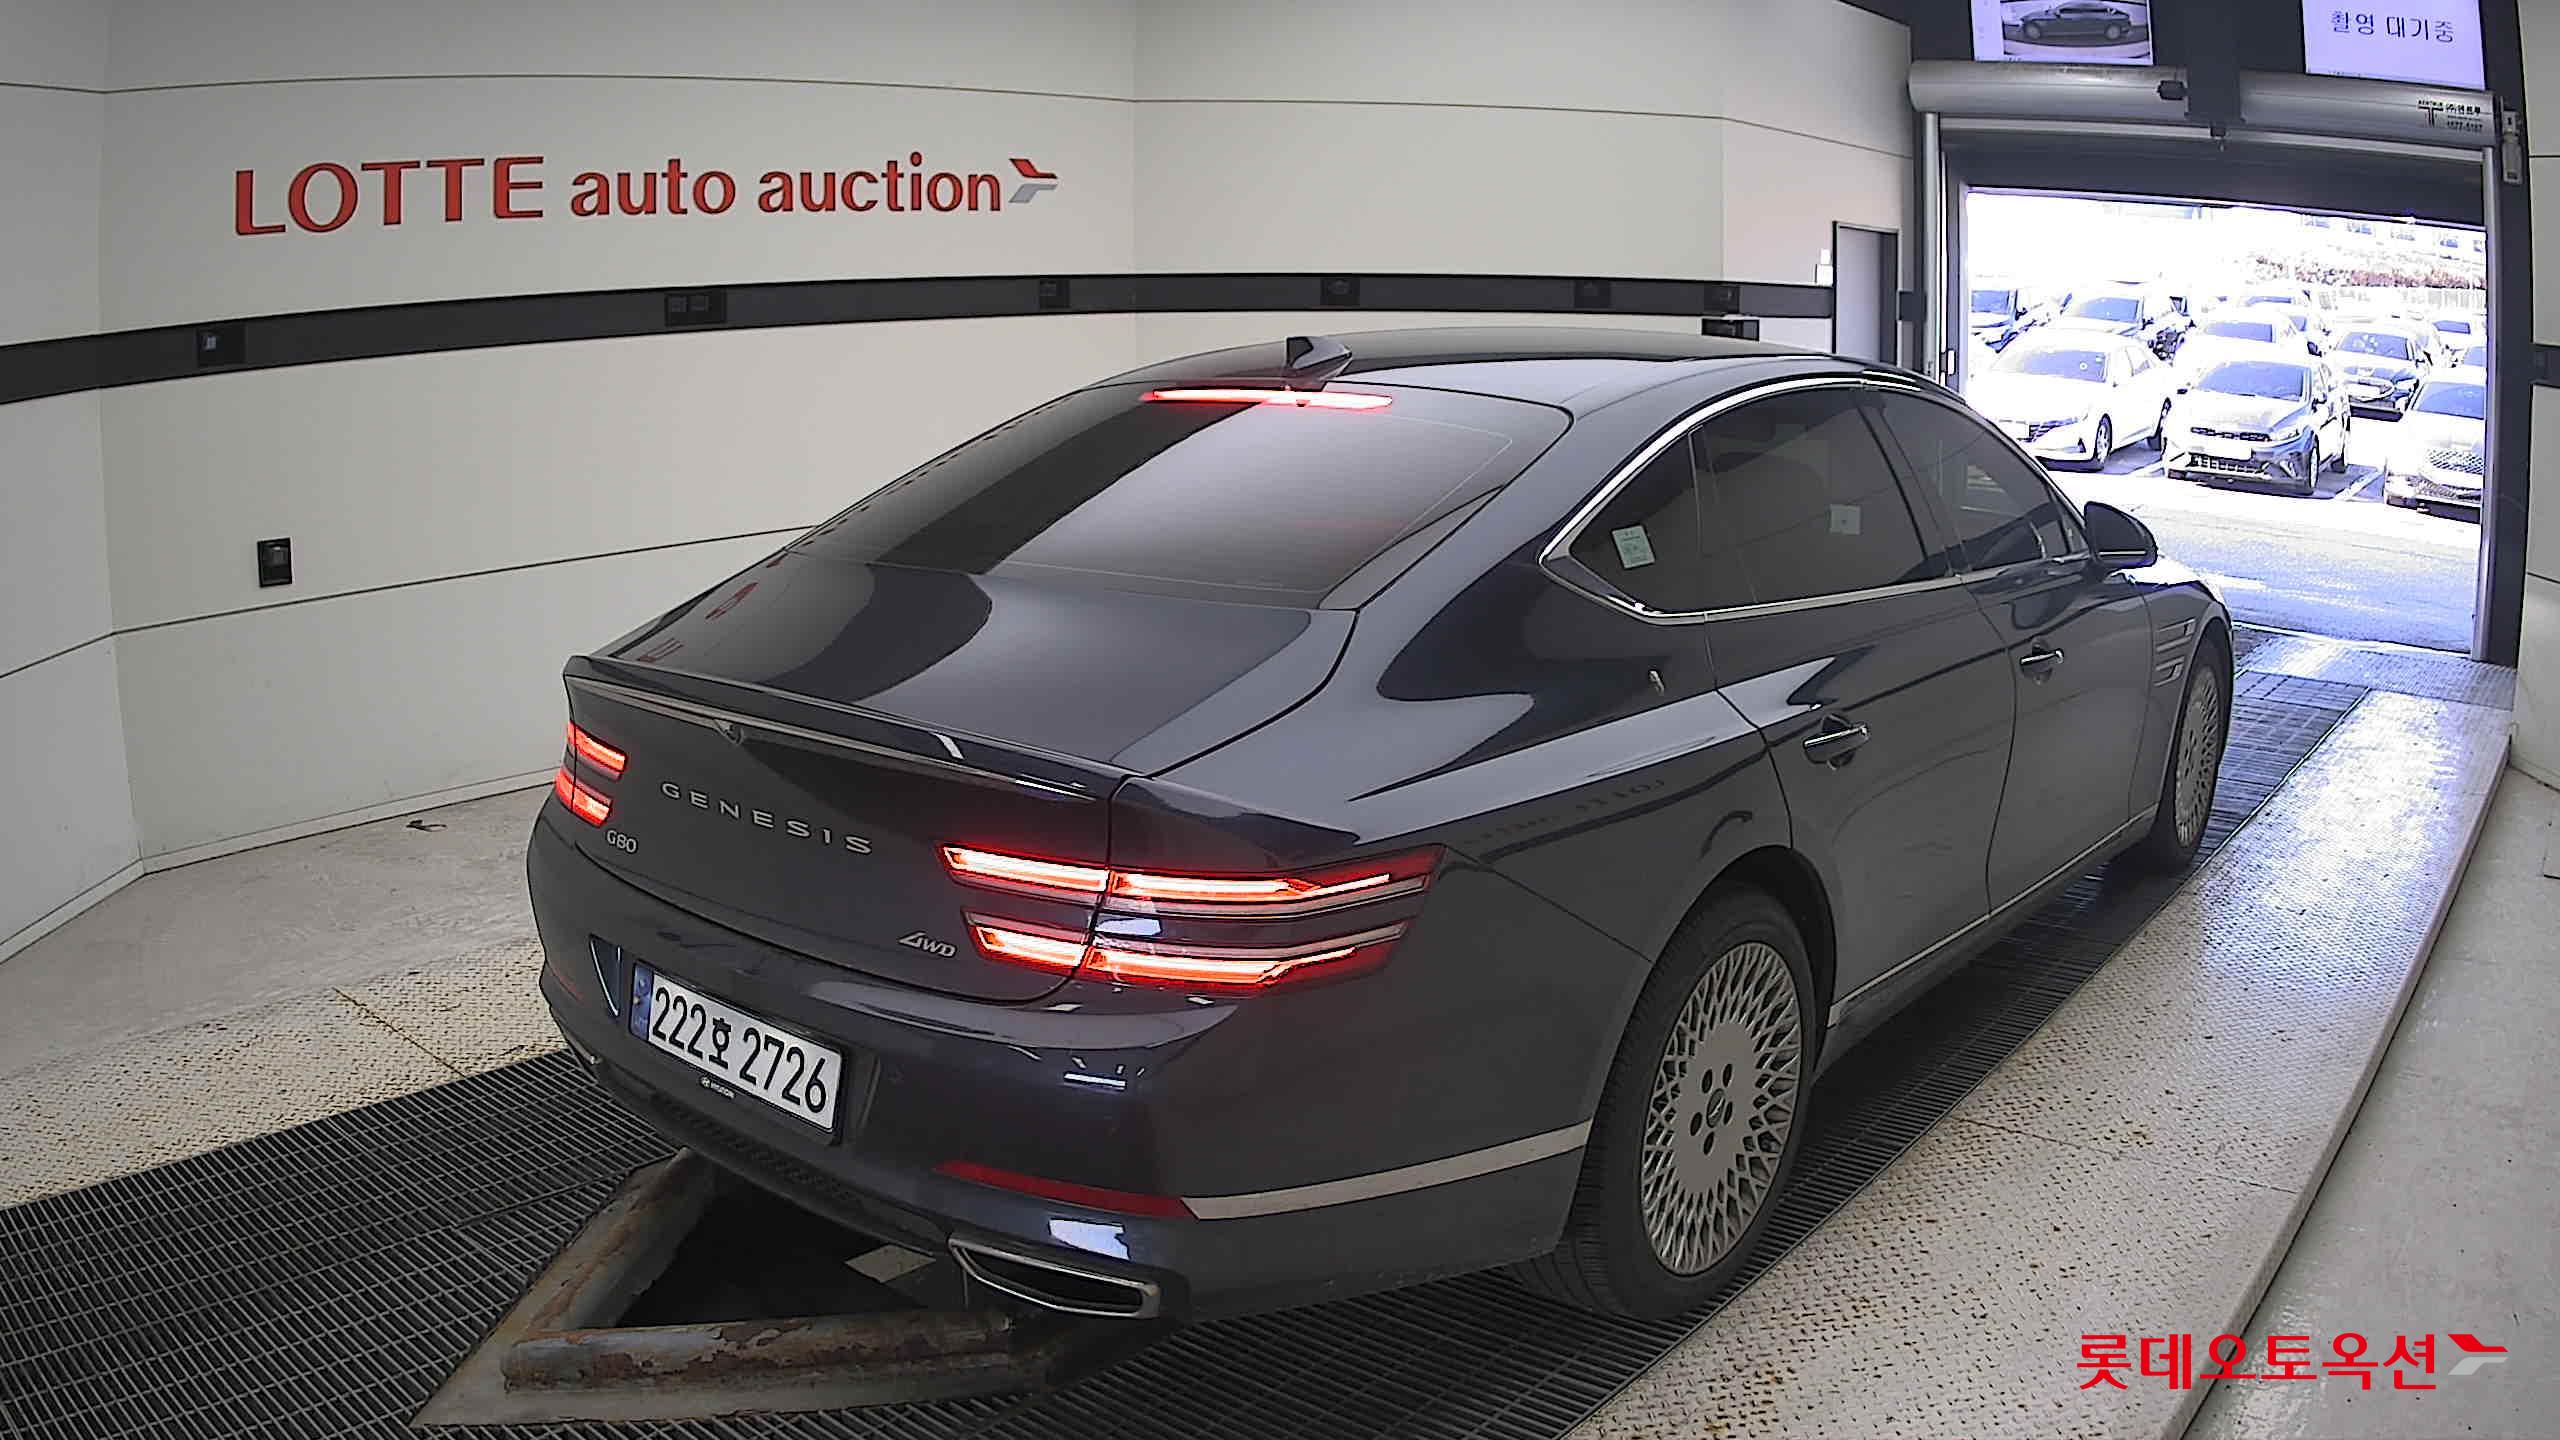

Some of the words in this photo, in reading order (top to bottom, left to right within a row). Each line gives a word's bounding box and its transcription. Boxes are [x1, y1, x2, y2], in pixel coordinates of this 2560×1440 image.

[2386, 15, 2455, 44] 대기중
[235, 156, 544, 235] LOTTE
[571, 158, 736, 216] auto
[759, 152, 1003, 214] auction
[605, 828, 638, 854] G80
[660, 782, 872, 855] GENESIS
[898, 931, 957, 958] 4WD
[652, 986, 733, 1071] 222호
[739, 1027, 828, 1115] 2726
